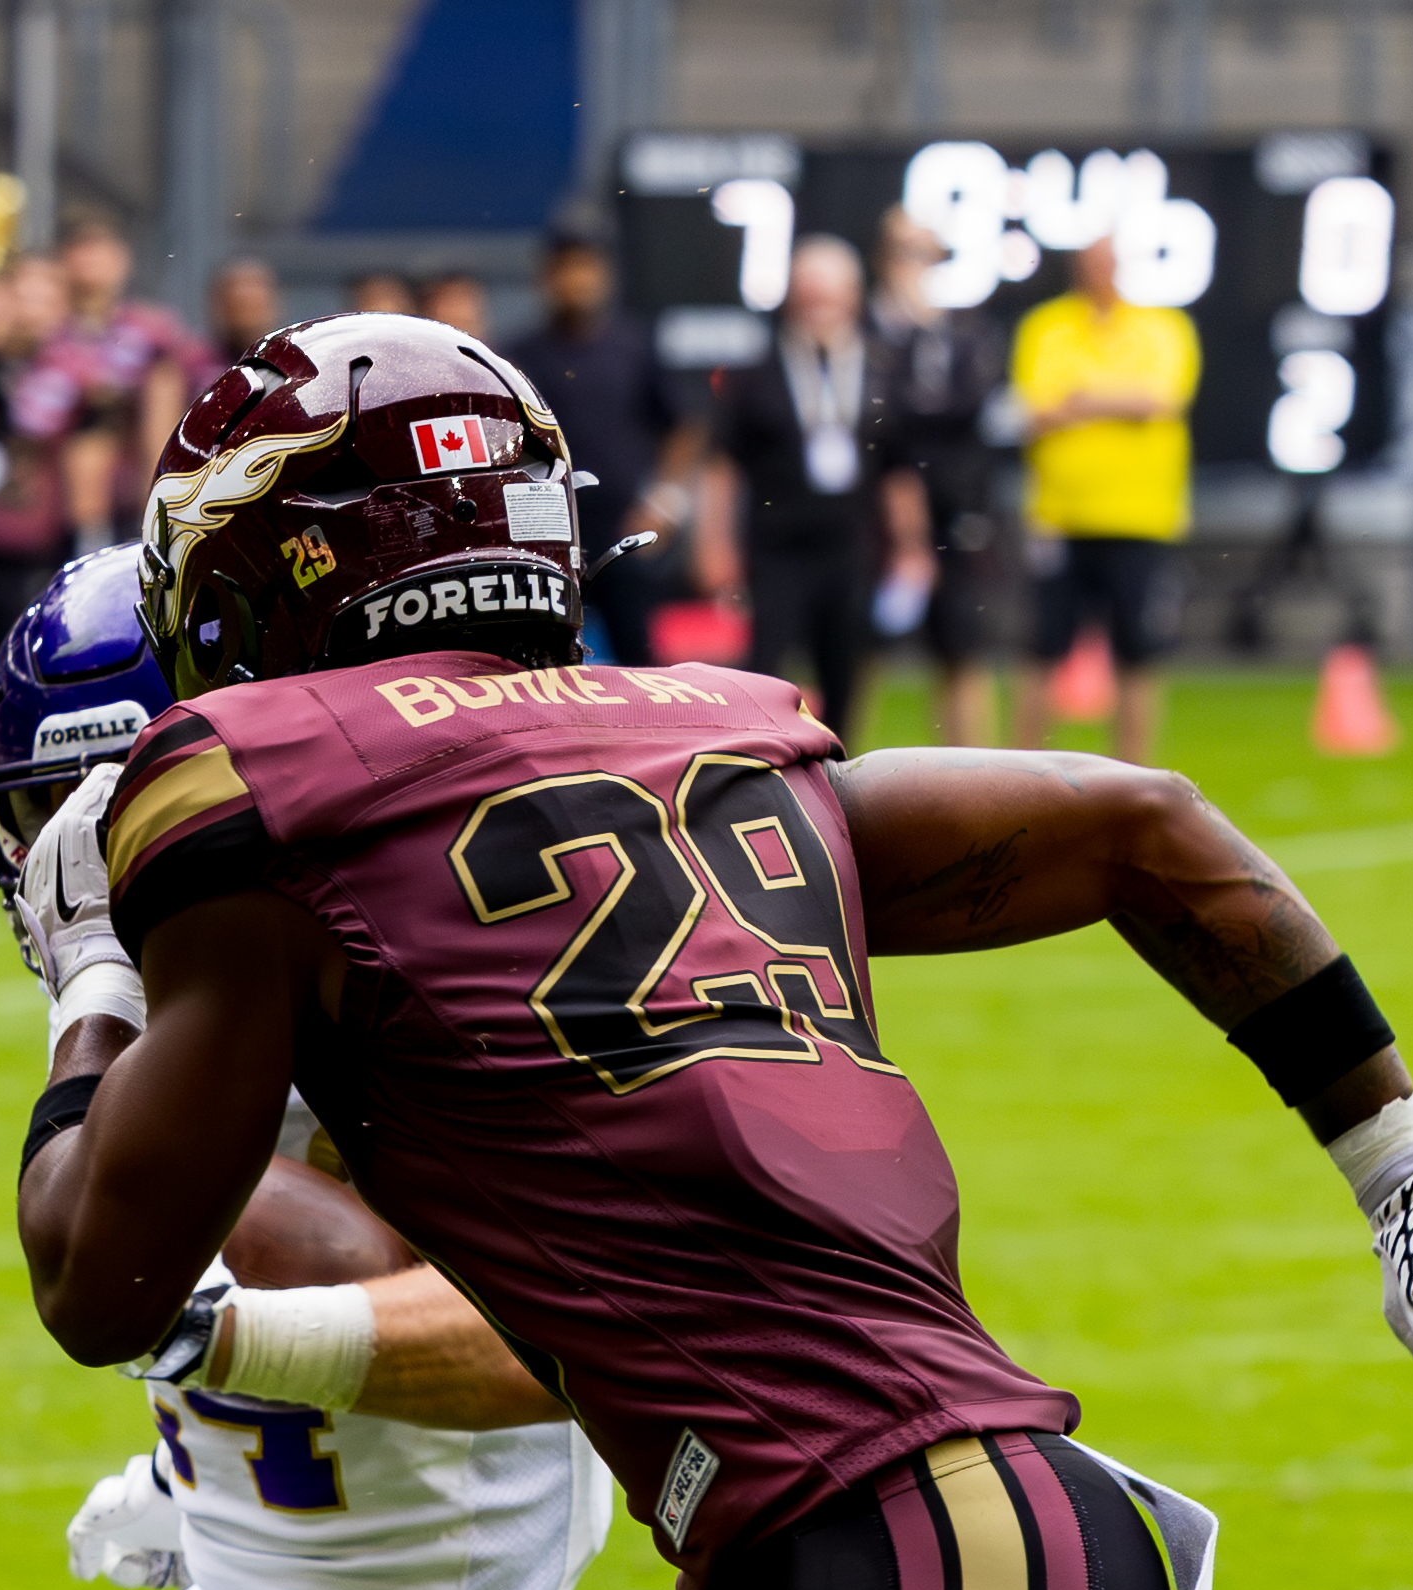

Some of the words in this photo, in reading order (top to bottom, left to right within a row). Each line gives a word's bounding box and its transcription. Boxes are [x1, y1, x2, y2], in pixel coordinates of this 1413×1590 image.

[712, 179, 794, 311] 7
[1300, 176, 1394, 315] 0
[1268, 350, 1355, 473] 2
[280, 525, 337, 589] 29
[364, 574, 566, 640] FORELLE
[40, 718, 138, 748] FORELLE
[619, 670, 729, 706] JR.
[445, 751, 907, 1096] 29
